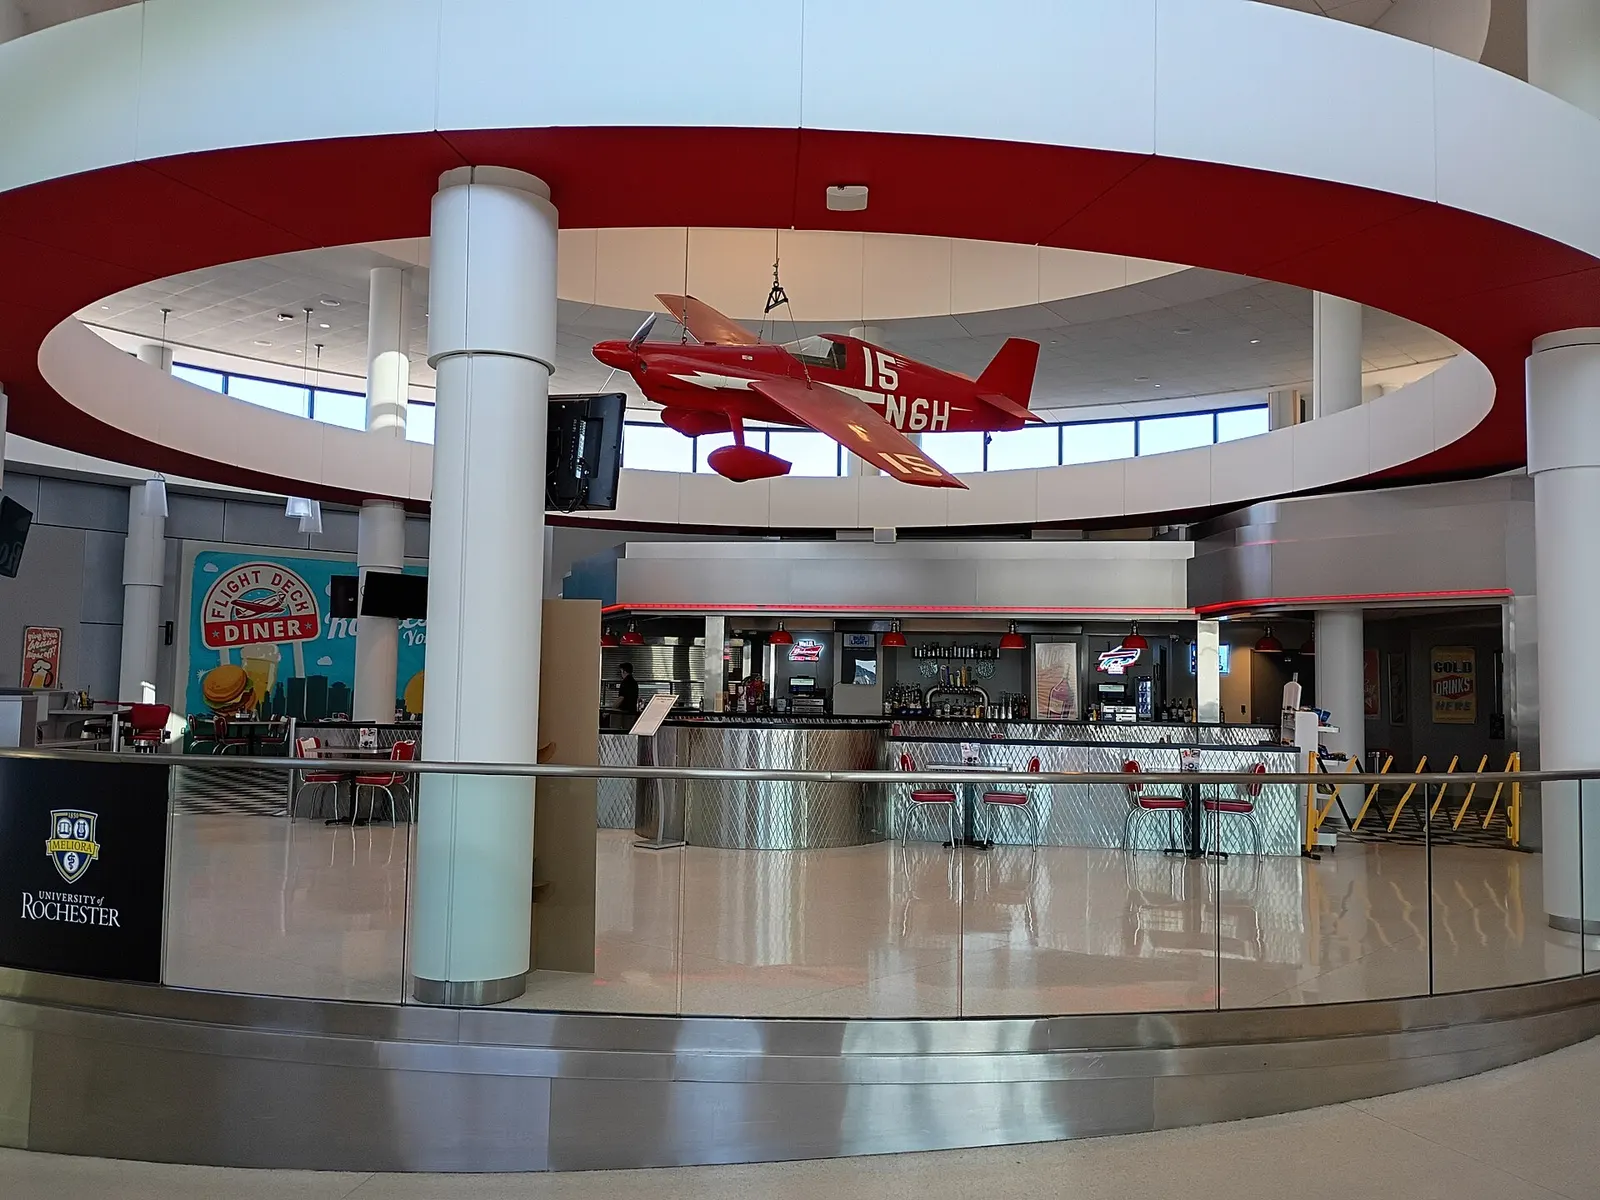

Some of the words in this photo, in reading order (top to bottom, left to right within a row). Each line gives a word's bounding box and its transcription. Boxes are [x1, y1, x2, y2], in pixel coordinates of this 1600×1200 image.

[862, 346, 899, 391] 15
[885, 394, 950, 431] N6H
[877, 452, 943, 477] 15
[211, 570, 261, 619] FLIGHT
[270, 572, 310, 613] DECK
[224, 618, 302, 643] DINER
[1434, 660, 1473, 674] COLD
[1435, 677, 1471, 696] DRINKS
[1435, 701, 1472, 711] HERE
[52, 840, 93, 853] MELIORA
[21, 891, 121, 928] ROCHESTER
[38, 890, 96, 905] UNIVERSITY
[96, 896, 105, 907] of
